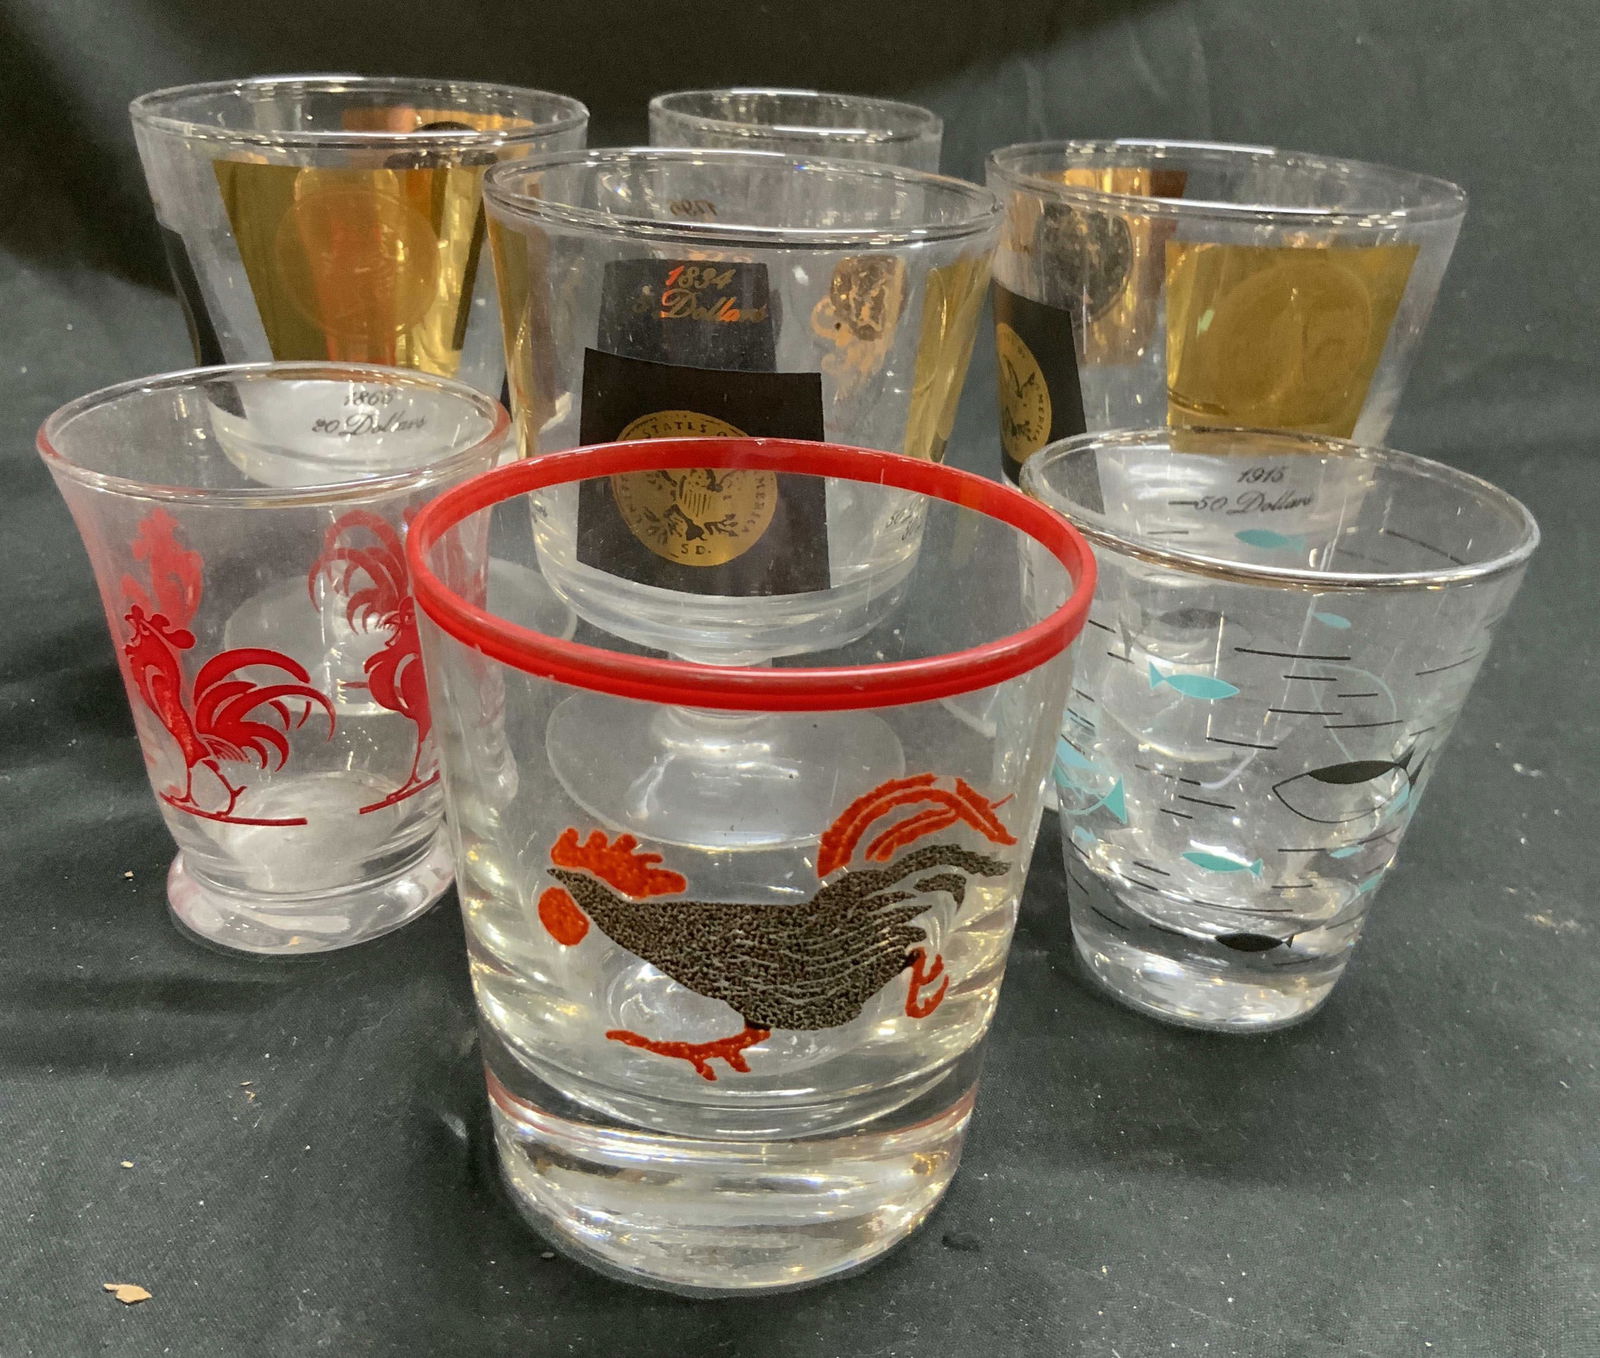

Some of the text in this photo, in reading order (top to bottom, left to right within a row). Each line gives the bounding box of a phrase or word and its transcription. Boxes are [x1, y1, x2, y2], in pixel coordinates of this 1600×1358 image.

[665, 265, 736, 290] 1834
[338, 410, 427, 436] Dollars
[1237, 465, 1289, 483] 1915
[741, 476, 767, 533] MERICA
[1194, 489, 1313, 515] 50 Dollars
